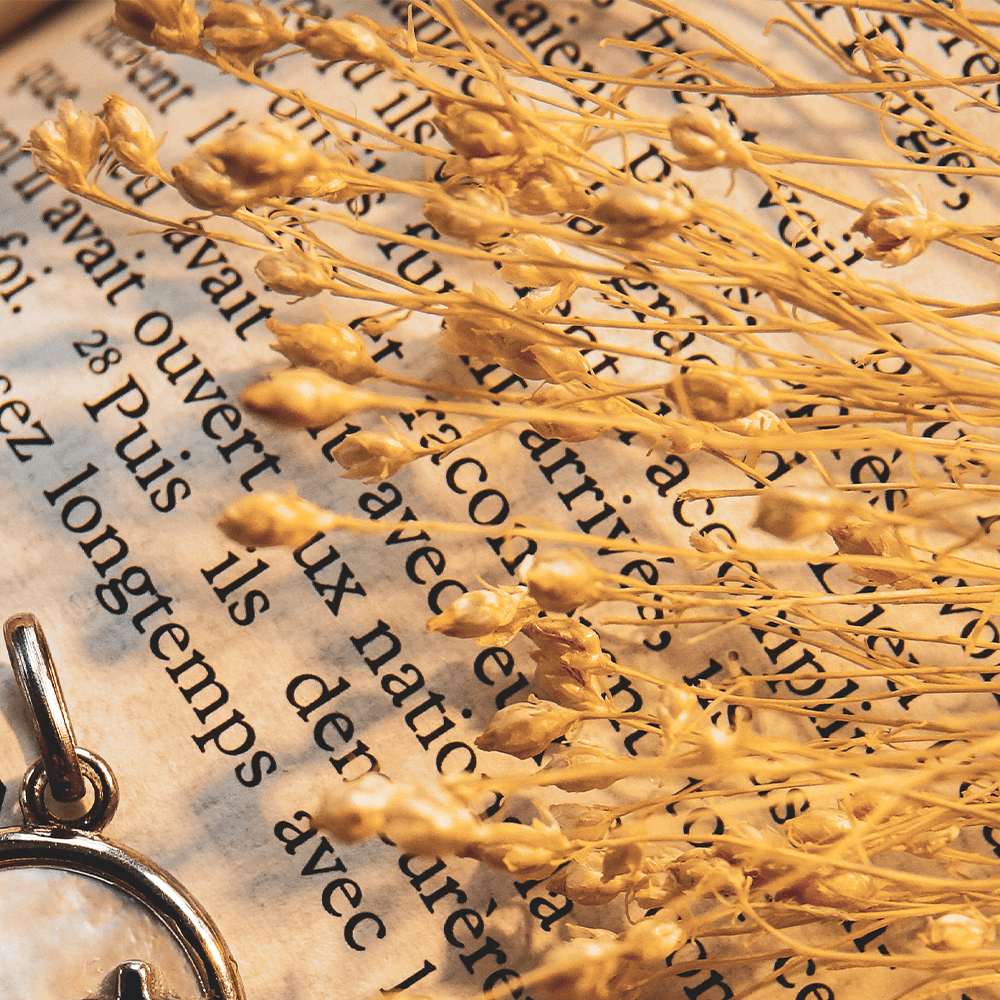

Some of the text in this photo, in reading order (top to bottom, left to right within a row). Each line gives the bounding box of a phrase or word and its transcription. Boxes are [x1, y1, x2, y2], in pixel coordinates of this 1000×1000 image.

[161, 202, 275, 342] avait
[41, 193, 146, 307] avait
[134, 310, 282, 493] ouvert
[292, 531, 367, 617] ux
[72, 330, 123, 375] 28
[83, 374, 192, 514] Puis
[200, 534, 271, 627] ils
[43, 462, 278, 789] longtemps
[273, 810, 387, 952] avec
